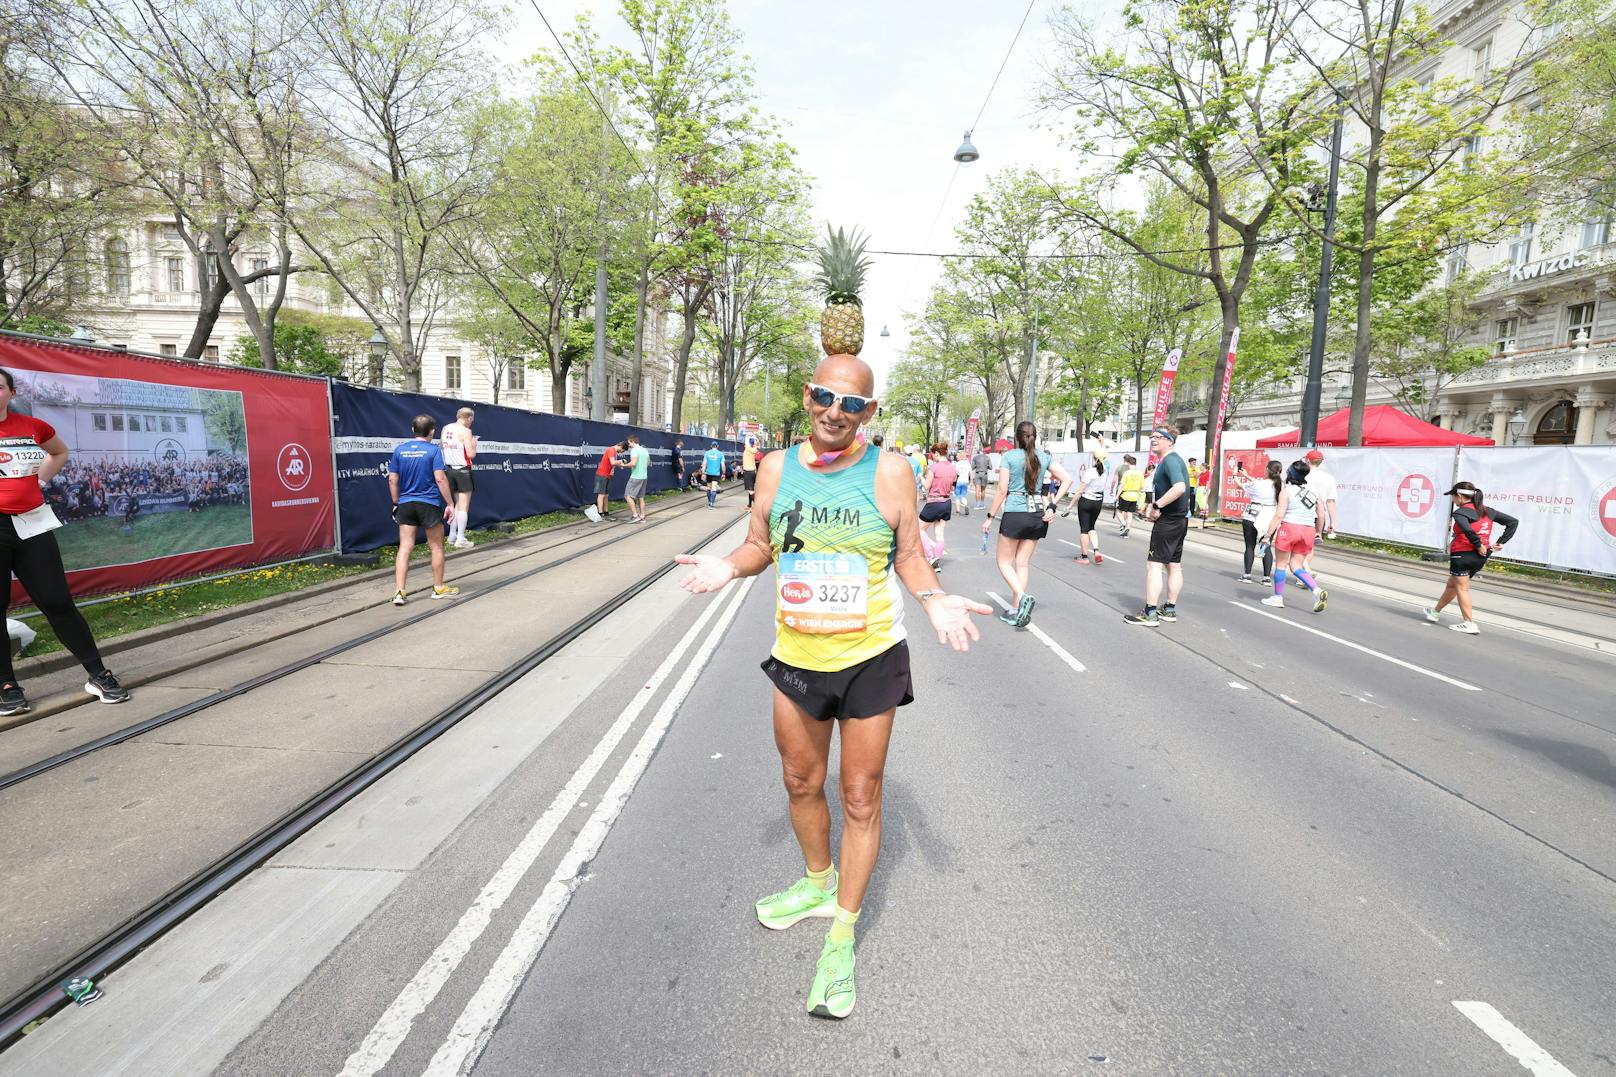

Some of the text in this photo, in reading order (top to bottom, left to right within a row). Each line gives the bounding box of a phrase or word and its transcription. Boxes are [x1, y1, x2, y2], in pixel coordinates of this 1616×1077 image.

[1157, 377, 1170, 413] HILFE
[352, 468, 380, 477] MARATHON
[1226, 489, 1243, 498] FIRST
[1225, 501, 1244, 511] POSTE
[1538, 504, 1573, 514] WIEN
[819, 585, 861, 603] 3237
